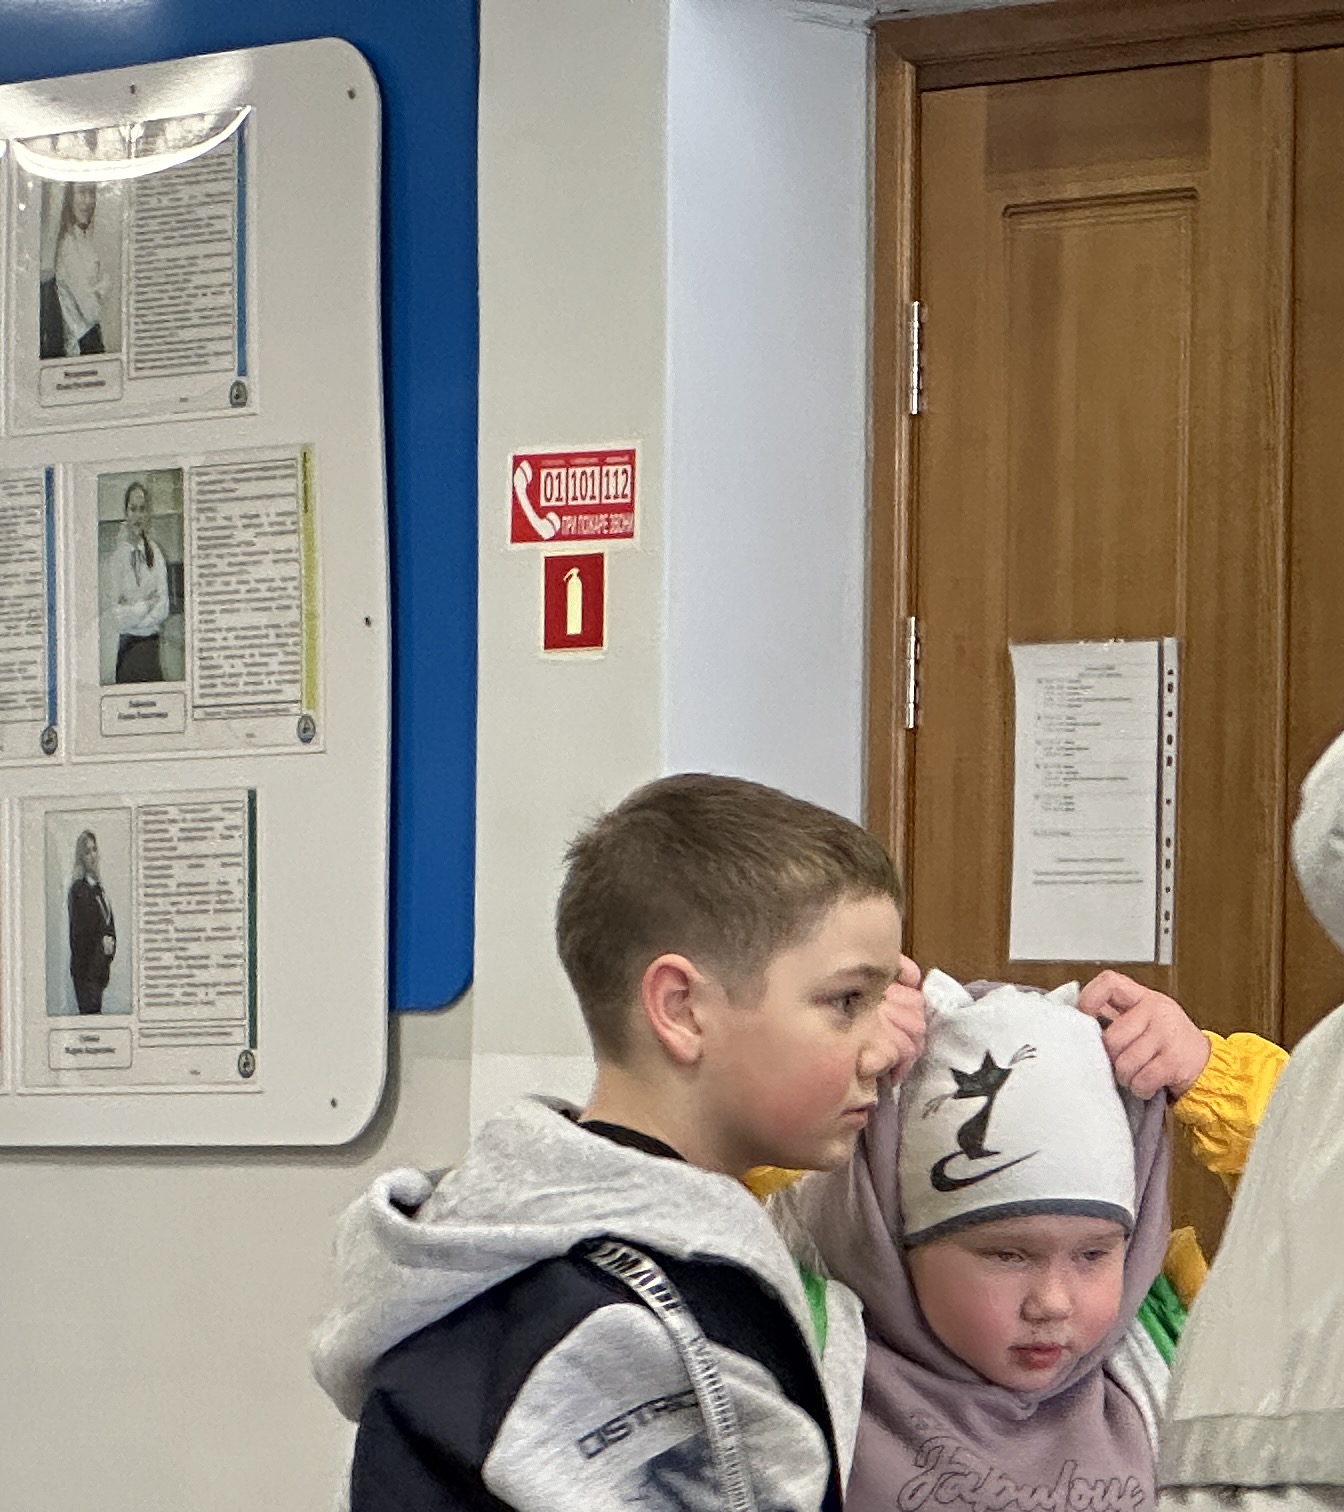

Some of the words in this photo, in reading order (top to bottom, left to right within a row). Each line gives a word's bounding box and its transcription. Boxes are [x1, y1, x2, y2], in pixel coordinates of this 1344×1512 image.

[544, 472, 563, 502] 01
[571, 469, 597, 501] 101
[604, 468, 629, 500] 112
